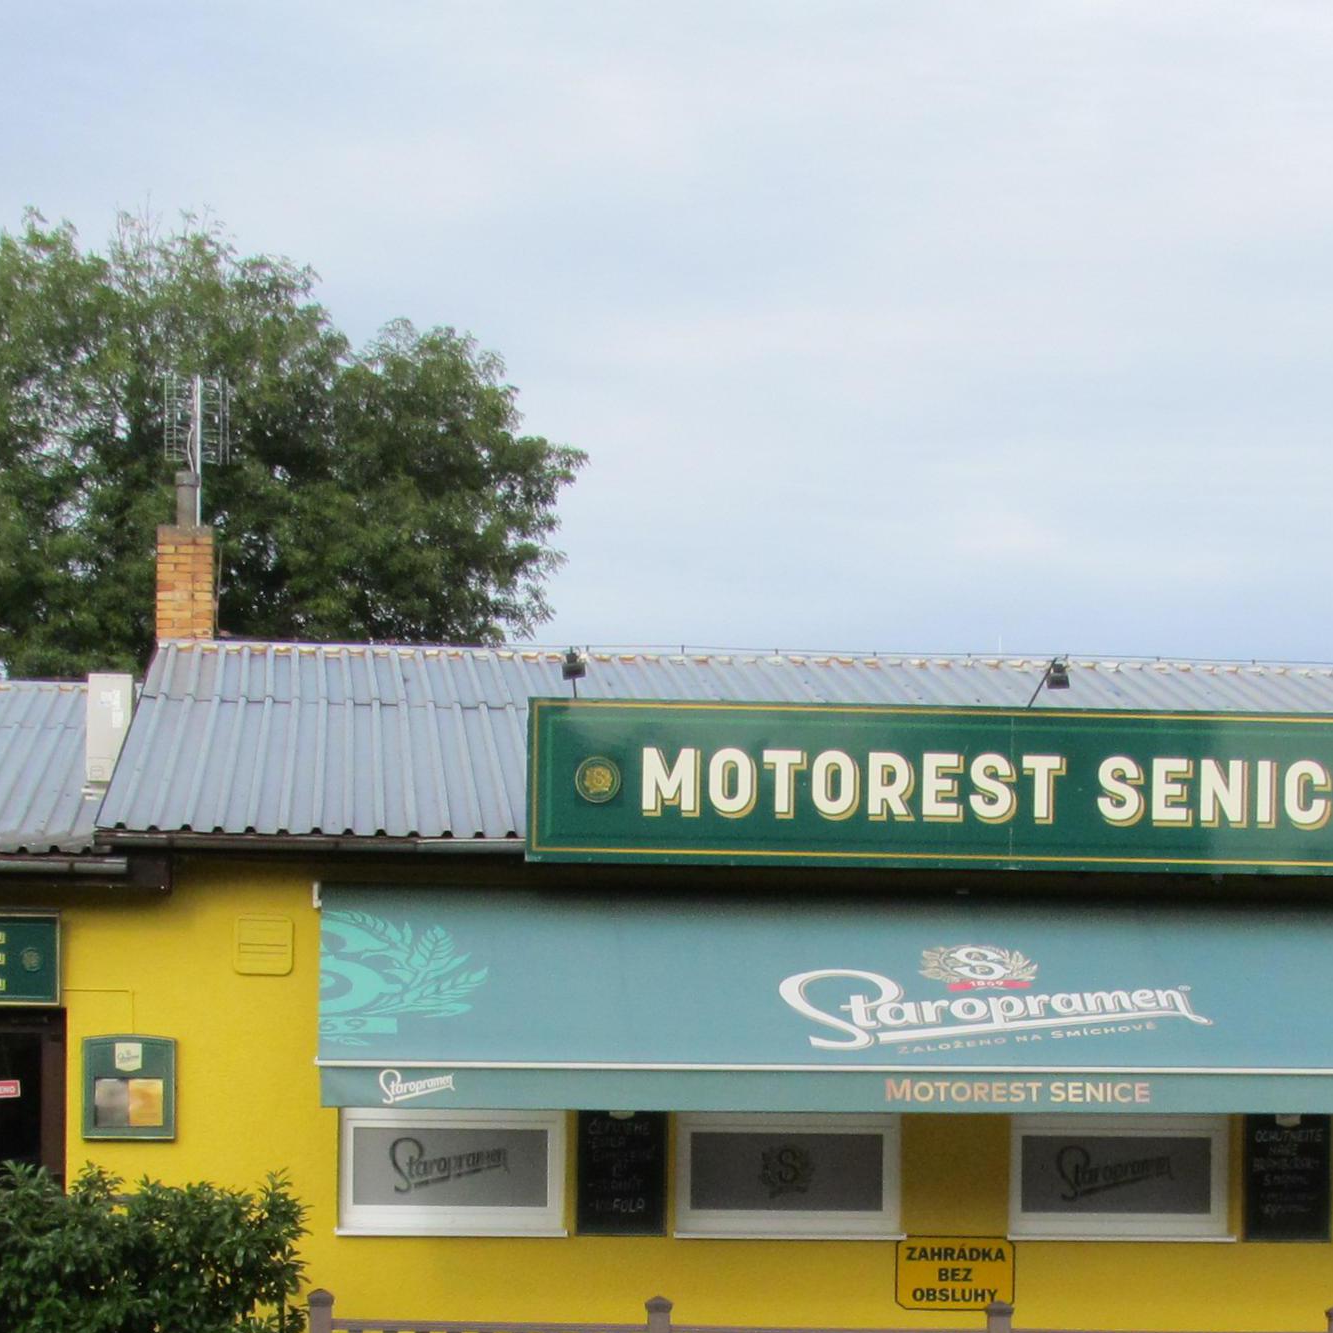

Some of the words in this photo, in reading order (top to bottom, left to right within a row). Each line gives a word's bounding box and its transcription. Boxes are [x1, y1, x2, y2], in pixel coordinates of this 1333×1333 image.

[641, 746, 1067, 824] MOTOREST
[778, 969, 1213, 1050] Staropramen
[898, 1036, 1007, 1055] ZALOŽENO
[1015, 1033, 1043, 1043] NA
[379, 1069, 455, 1104] Staropramen
[885, 1078, 1042, 1102] MOTOREST
[1050, 1082, 1151, 1103] SENICE
[389, 1137, 510, 1193] Staropramen
[906, 1242, 1006, 1262] ZAHRÁDKA
[938, 1268, 973, 1282] BEZ
[912, 1288, 998, 1303] OBSLUHY
